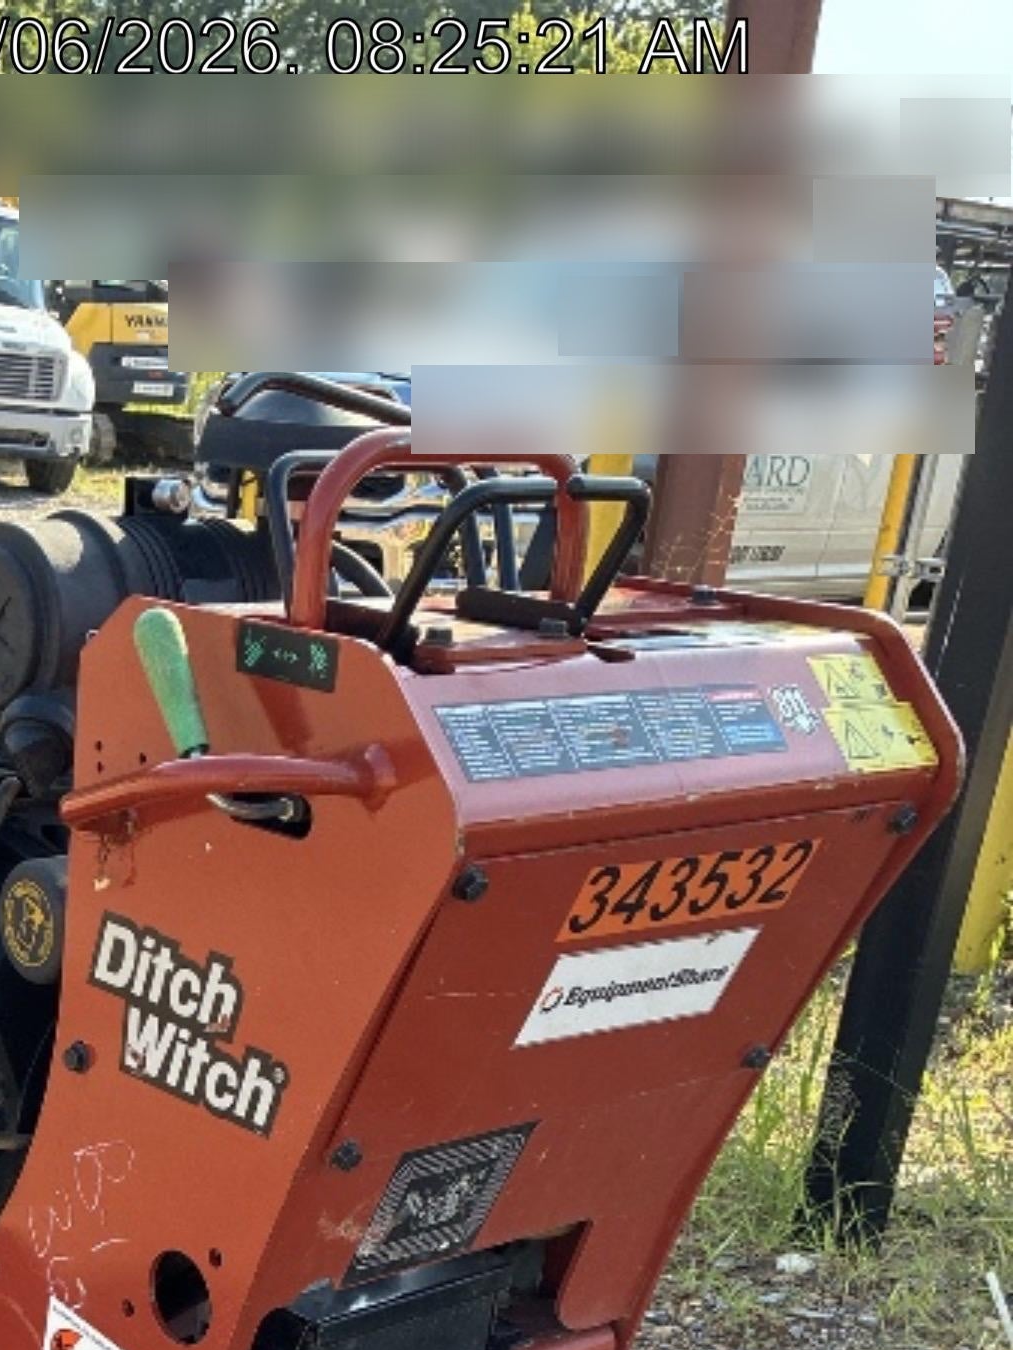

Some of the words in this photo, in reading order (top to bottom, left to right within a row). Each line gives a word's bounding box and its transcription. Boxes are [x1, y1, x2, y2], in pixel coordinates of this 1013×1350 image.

[569, 840, 814, 933] 343532
[93, 920, 238, 1032] Ditch
[563, 964, 729, 1008] EquipmentShare
[123, 1006, 277, 1127] Witch
